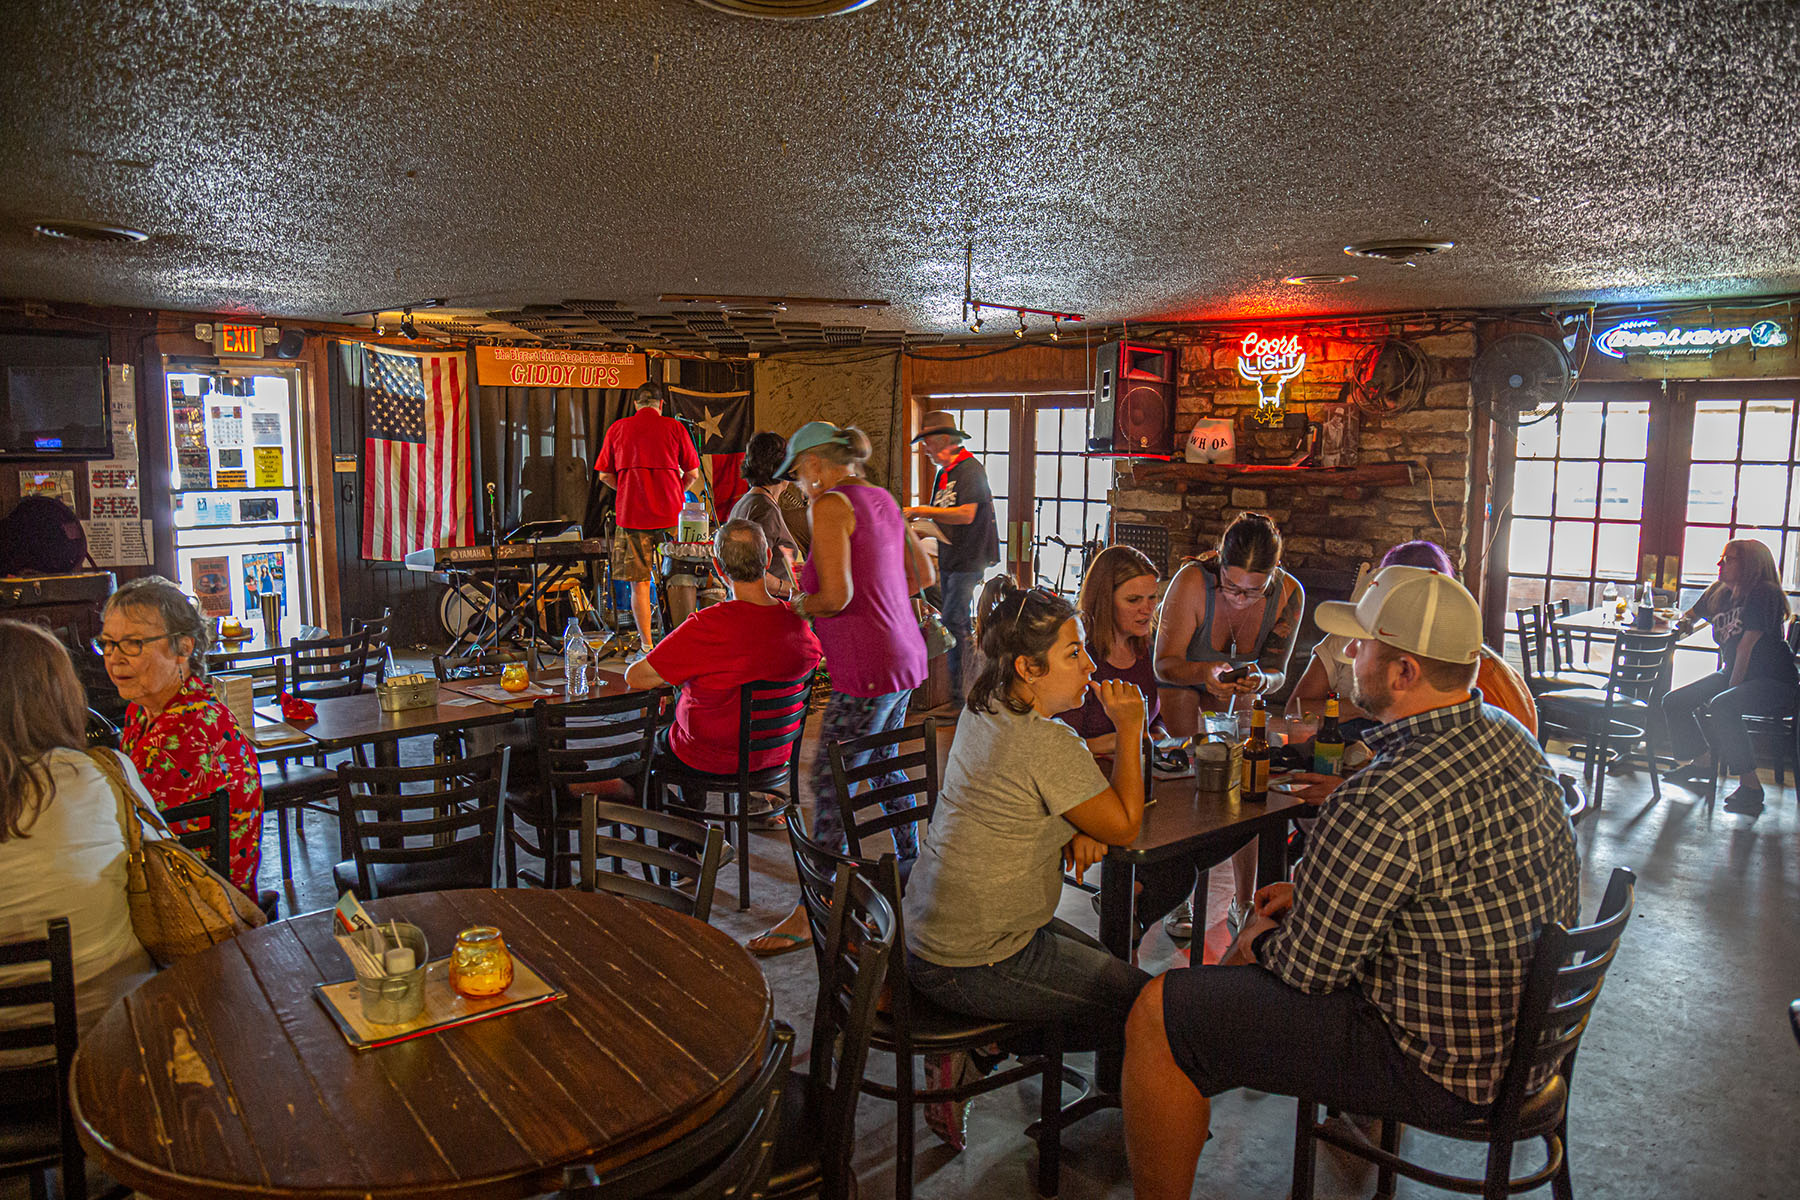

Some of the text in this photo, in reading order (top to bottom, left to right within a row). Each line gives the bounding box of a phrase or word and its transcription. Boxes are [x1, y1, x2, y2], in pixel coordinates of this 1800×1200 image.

[223, 324, 257, 353] EXIT
[1240, 332, 1302, 357] Coors
[495, 349, 510, 360] The
[510, 348, 539, 362] Biggest
[539, 350, 560, 362] Little
[560, 352, 580, 364] Stage
[589, 352, 610, 365] South
[611, 353, 634, 365] Austin
[1246, 354, 1298, 370] LIGHT
[511, 363, 620, 387] GIDDY UPS
[683, 526, 708, 542] Tips
[458, 549, 487, 559] YAMAHA
